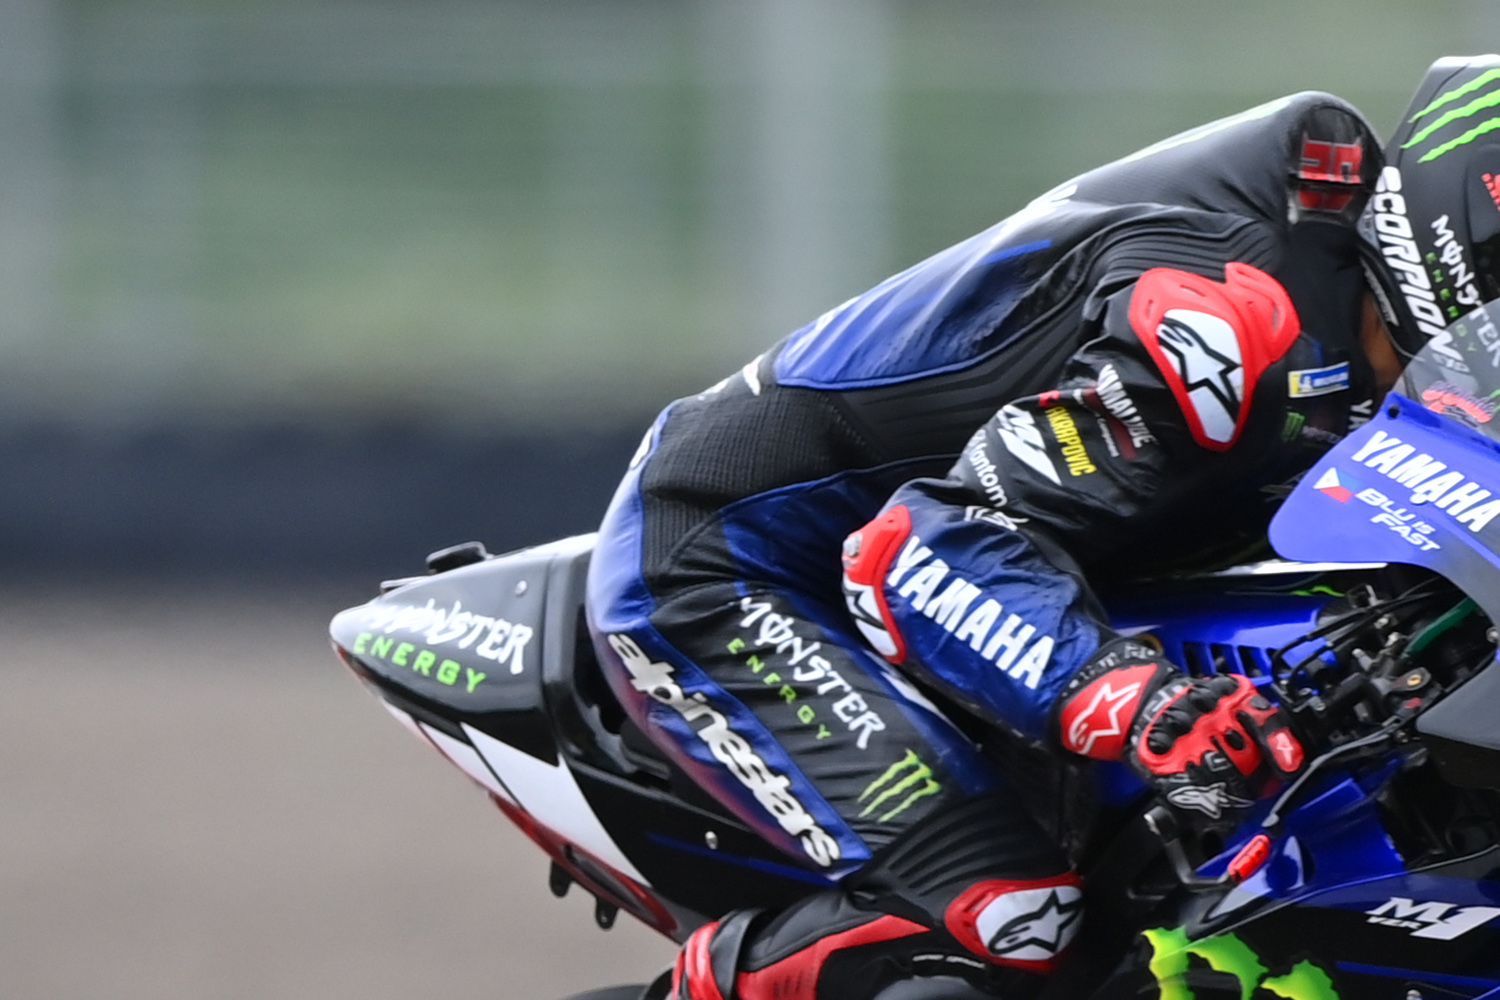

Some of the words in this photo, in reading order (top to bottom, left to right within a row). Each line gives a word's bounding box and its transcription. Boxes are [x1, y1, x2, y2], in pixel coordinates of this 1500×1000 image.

[1374, 166, 1464, 361] SCORPION
[1355, 488, 1416, 521] BLU
[1370, 513, 1441, 551] FAST
[353, 632, 486, 693] ENERGY
[887, 535, 1055, 690] YAMAHA
[726, 638, 832, 740] ENERGY
[607, 633, 841, 867] alpinestars
